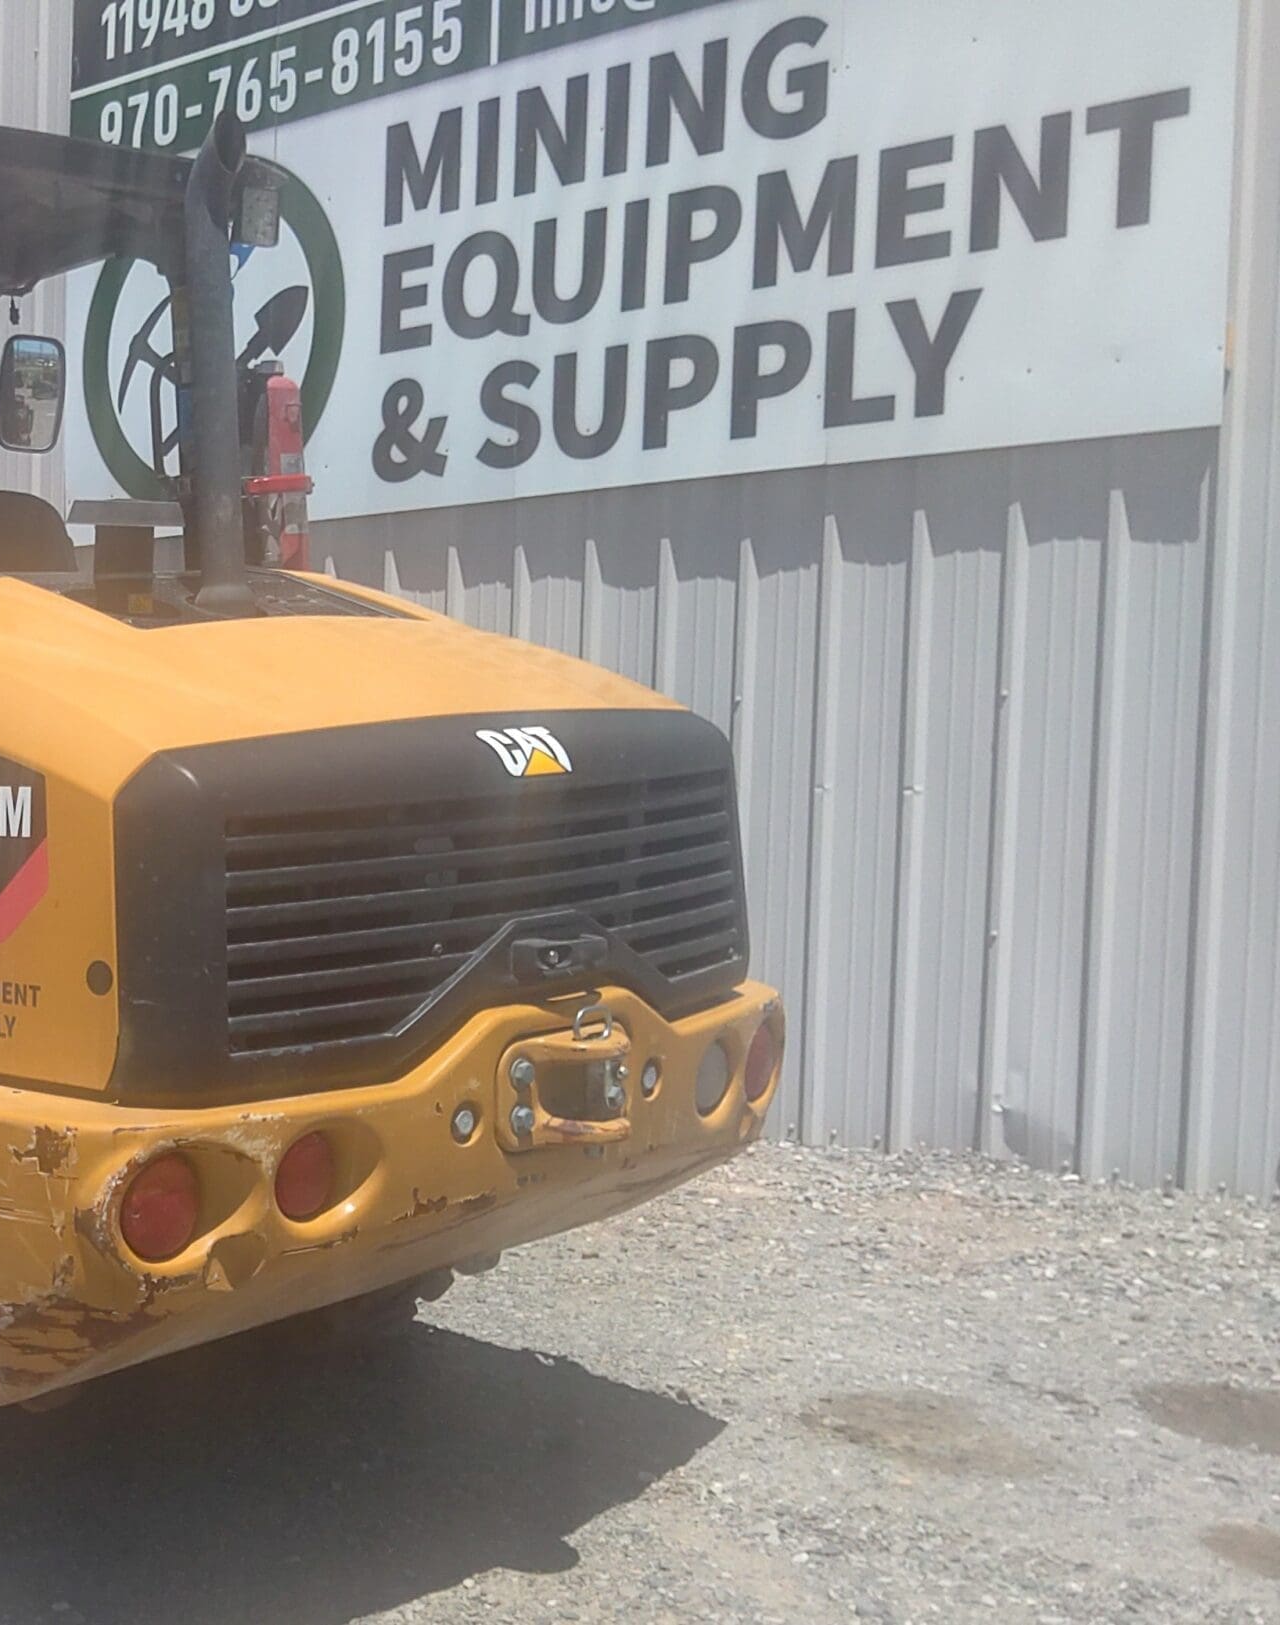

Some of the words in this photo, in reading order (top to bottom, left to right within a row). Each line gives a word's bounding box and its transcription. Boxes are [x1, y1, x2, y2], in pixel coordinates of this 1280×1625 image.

[100, 0, 462, 148] 970-765-8155
[384, 15, 829, 227] MINING
[380, 87, 1191, 355] EQUIPMENT
[371, 377, 448, 483] &
[475, 287, 984, 470] SUPPLY
[474, 726, 573, 777] CAT
